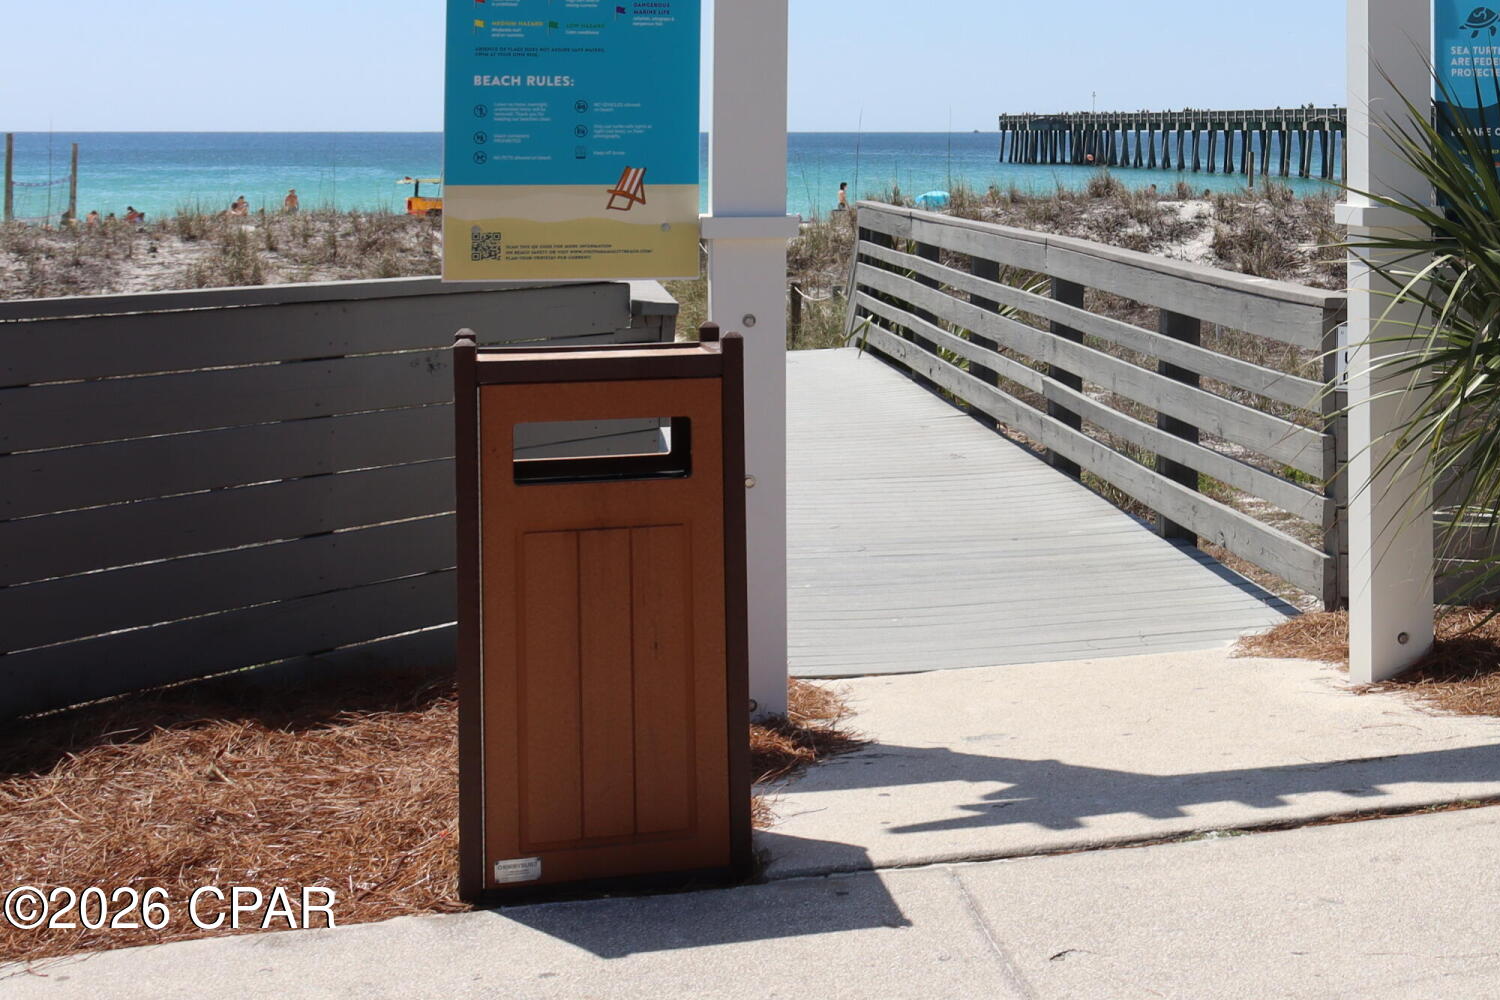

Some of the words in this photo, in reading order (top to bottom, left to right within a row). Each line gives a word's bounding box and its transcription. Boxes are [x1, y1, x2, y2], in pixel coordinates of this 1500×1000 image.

[1450, 46, 1470, 55] SEA
[1450, 57, 1471, 66] ARE
[474, 75, 521, 86] BEACH
[527, 75, 574, 87] RULES:
